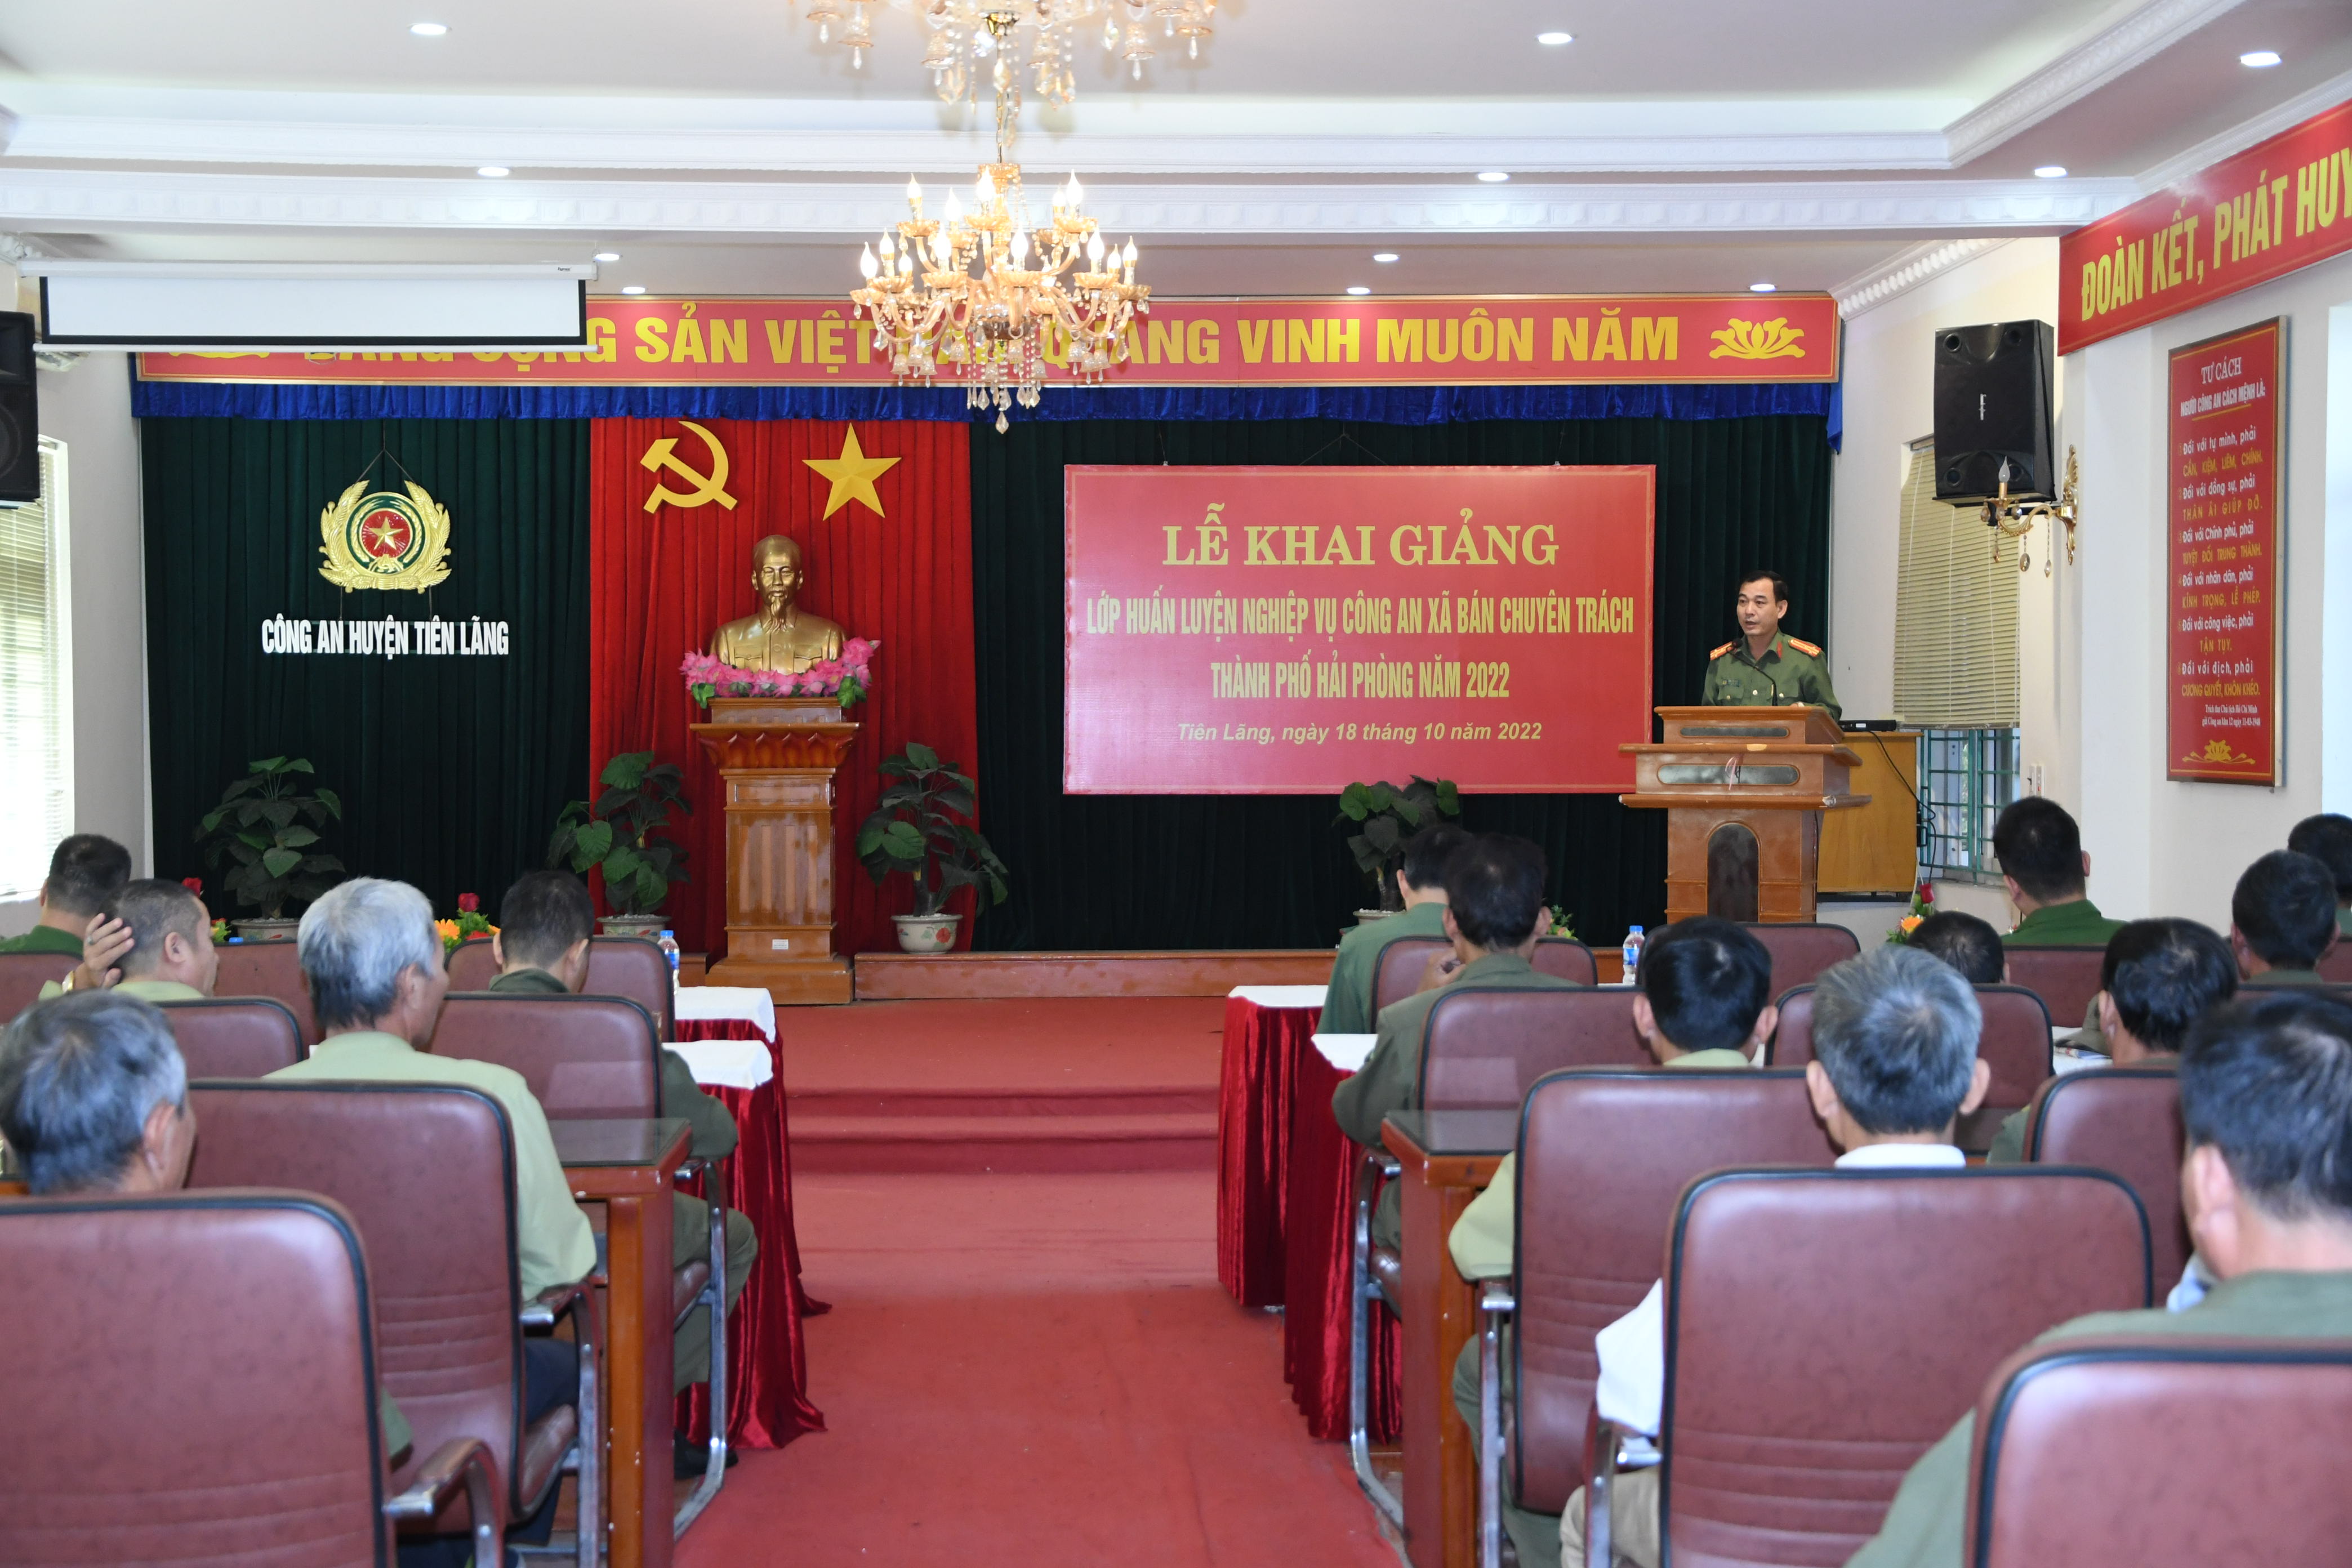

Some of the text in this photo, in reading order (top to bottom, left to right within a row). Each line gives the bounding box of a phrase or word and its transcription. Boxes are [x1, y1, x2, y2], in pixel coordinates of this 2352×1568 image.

[2082, 235, 2144, 322] ĐOÀN
[2151, 197, 2203, 293] KẾT,
[2213, 168, 2288, 269] PHÁT
[635, 301, 748, 363] SẢN
[764, 309, 877, 373] VIỆT
[1237, 318, 1360, 363] VINH
[1377, 308, 1534, 363] MUÔN
[1552, 307, 1678, 362] NĂM
[2216, 355, 2242, 380] CÁCH
[2213, 392, 2221, 408] AN
[2222, 386, 2237, 406] CÁCH
[2183, 439, 2194, 455] Đối
[2197, 437, 2207, 452] với
[2219, 432, 2237, 447] mình,
[2240, 424, 2256, 445] phải
[2183, 483, 2193, 500] Đối
[2196, 482, 2206, 496] với
[2208, 478, 2225, 495] đồng
[2240, 472, 2255, 492] phải
[2222, 497, 2242, 515] GIÚP
[1162, 502, 1559, 565] LỄ KHAI GIẢNG
[2183, 527, 2193, 542] Đối
[2195, 527, 2204, 541] với
[2205, 525, 2222, 540] Chính
[2239, 518, 2253, 538] phải
[2217, 546, 2236, 561] TRUNG
[2182, 571, 2193, 586] Đối
[2195, 571, 2204, 585] với
[2206, 570, 2221, 584] nhân
[2223, 569, 2237, 583] dân,
[2239, 564, 2253, 584] phải
[1086, 585, 1633, 642] LỚP HUẤN LUYỆN NGHIỆP VỤ CÔNG AN XÃ BÁN CHUYÊN TRÁCH
[2182, 616, 2193, 631] Đối
[2194, 616, 2203, 630] với
[2204, 616, 2220, 631] công
[2222, 614, 2238, 631] việc,
[2239, 611, 2253, 629] phải
[262, 613, 509, 660] CÔNG AN HUYỆN TIÊN LÃNG
[1211, 649, 1509, 698] THÀNH PHỐ HẢI PHÒNG NĂM 2022
[2182, 660, 2194, 675] Đối
[2198, 660, 2210, 674] với
[2235, 657, 2253, 676] phải
[1178, 723, 1542, 745] Tiên Lãng, ngày 18 tháng 10 năm 2022
